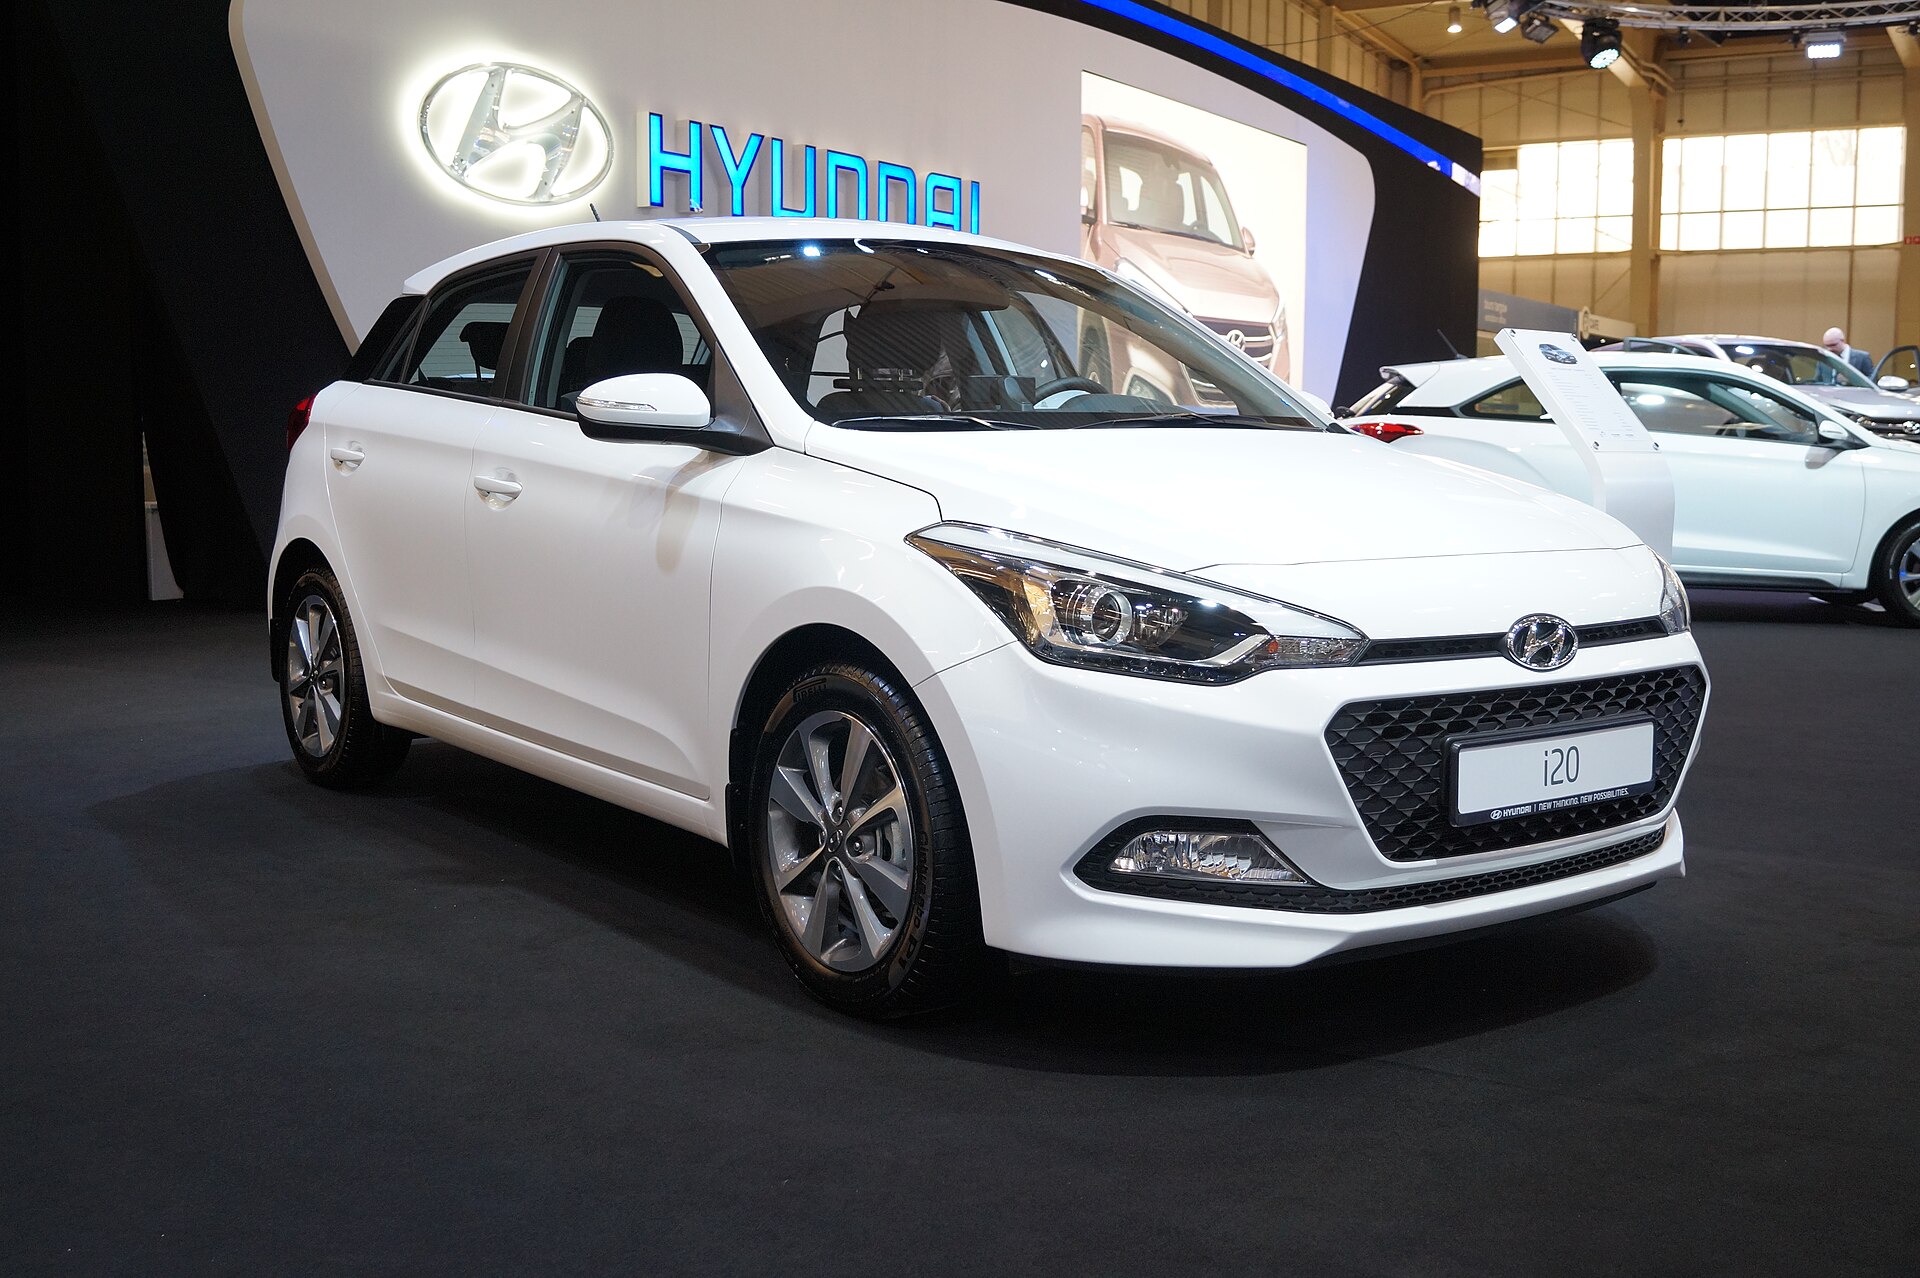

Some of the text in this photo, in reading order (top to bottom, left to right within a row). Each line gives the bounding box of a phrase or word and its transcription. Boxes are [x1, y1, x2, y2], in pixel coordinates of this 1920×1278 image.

[648, 111, 980, 235] HYUNDAI
[1544, 746, 1579, 786] i20
[1503, 805, 1531, 817] HYUNDAI
[1538, 802, 1552, 811] NEW
[1580, 795, 1593, 803] NEW
